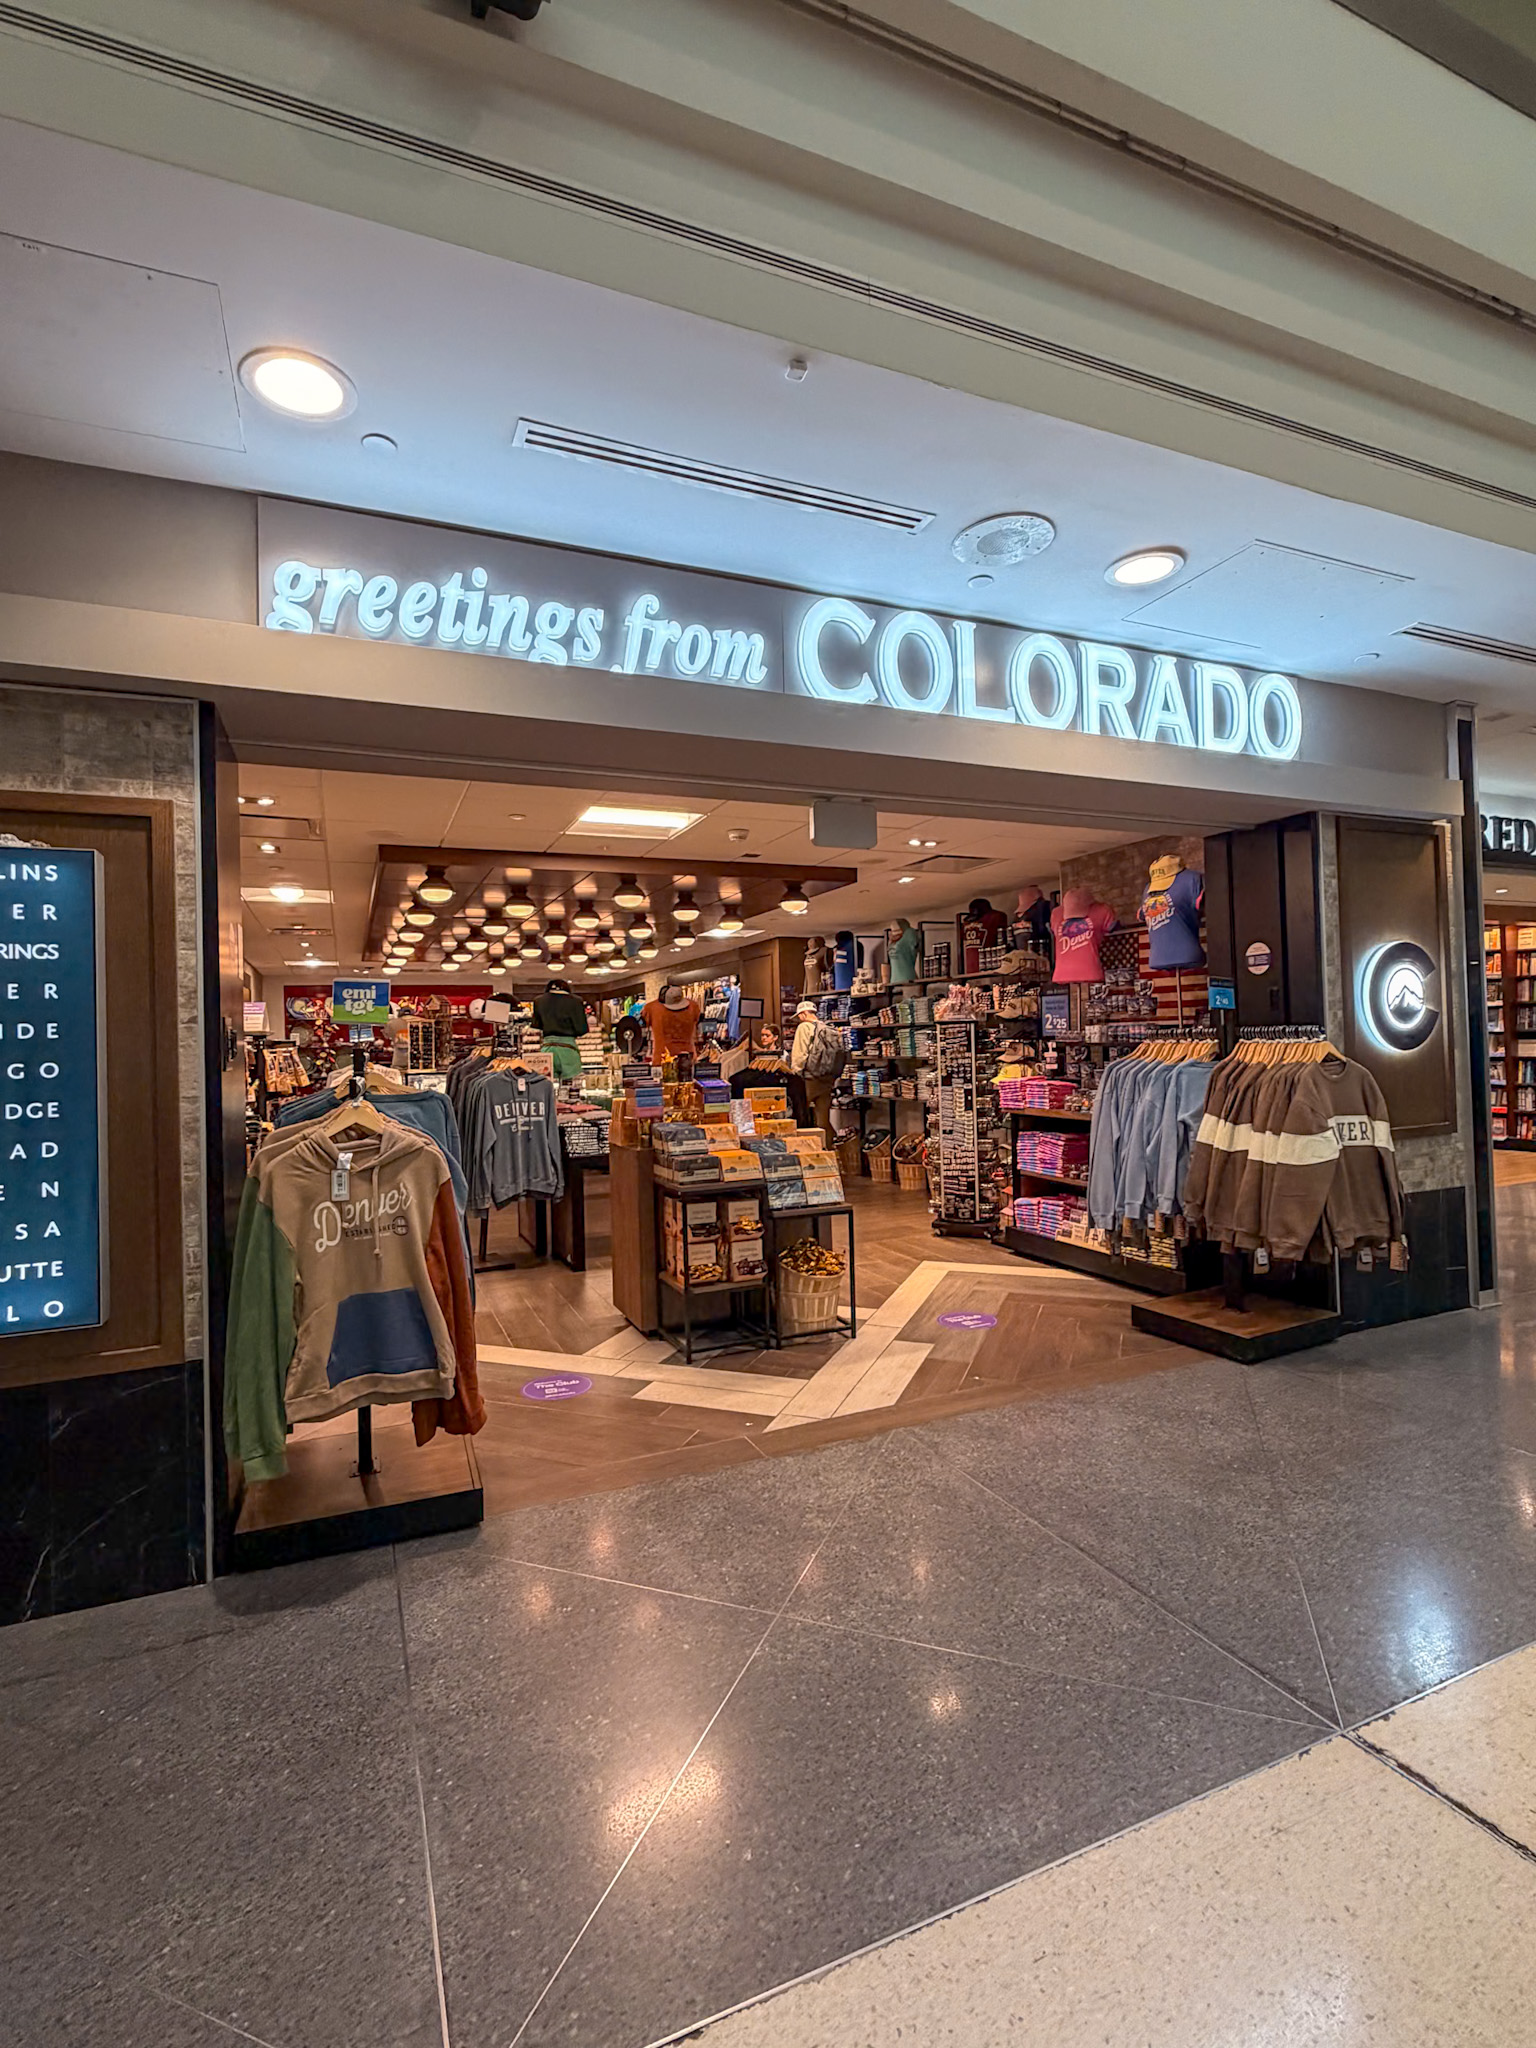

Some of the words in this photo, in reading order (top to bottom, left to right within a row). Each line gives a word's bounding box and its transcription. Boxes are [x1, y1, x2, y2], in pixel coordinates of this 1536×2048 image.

[265, 559, 605, 667] greetings
[609, 593, 768, 686] from
[797, 597, 1303, 762] COLORADO
[342, 985, 377, 999] emi
[344, 998, 375, 1016] tgt
[1044, 1013, 1054, 1029] 2
[4, 1101, 60, 1120] DGE
[313, 1182, 414, 1253] Denver
